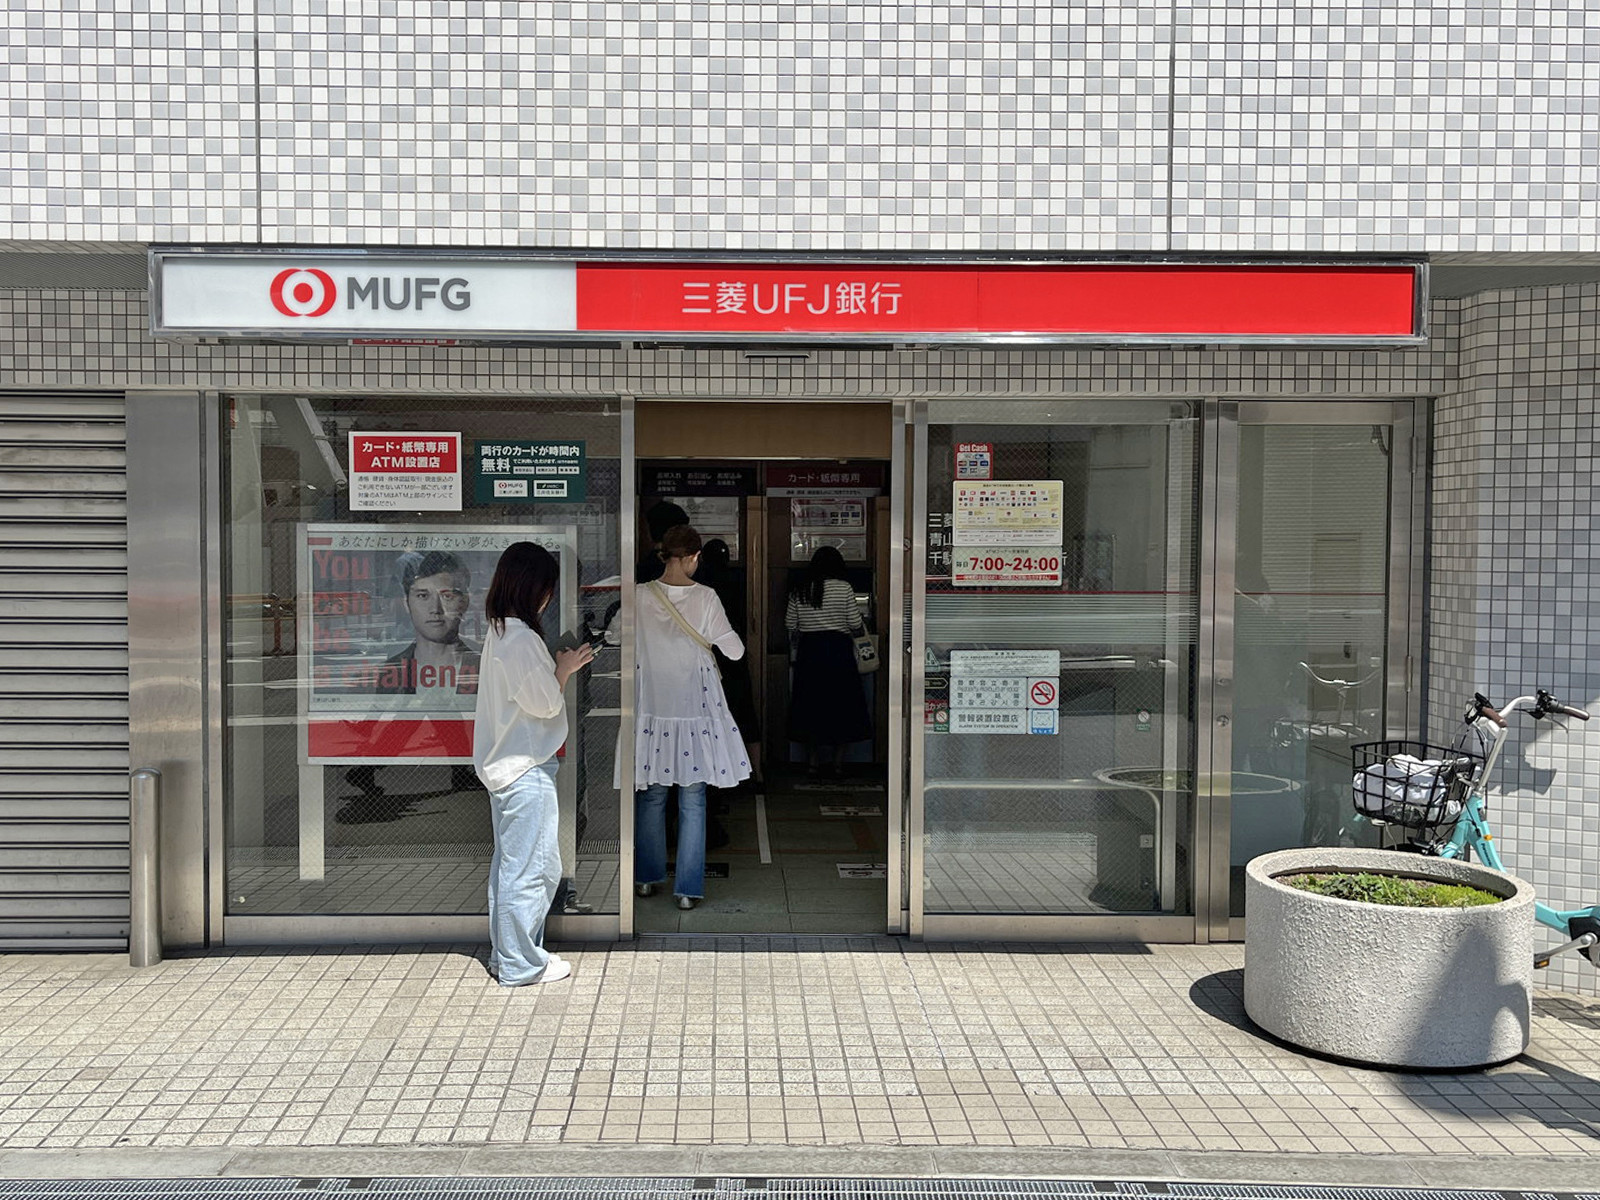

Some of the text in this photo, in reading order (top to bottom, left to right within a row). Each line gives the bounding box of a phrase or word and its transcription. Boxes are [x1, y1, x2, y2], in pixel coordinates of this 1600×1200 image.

[347, 277, 471, 311] MUFG
[682, 281, 903, 315] 三菱UFJ銀行
[362, 441, 449, 453] カード・紙幣専用
[481, 445, 580, 457] 両行のカードが時間内
[971, 444, 988, 452] Cash
[371, 456, 441, 468] ATM設置店
[481, 457, 511, 472] 無料
[314, 551, 369, 580] You
[314, 592, 371, 615] can
[314, 621, 350, 651] be
[340, 658, 478, 694] challeng
